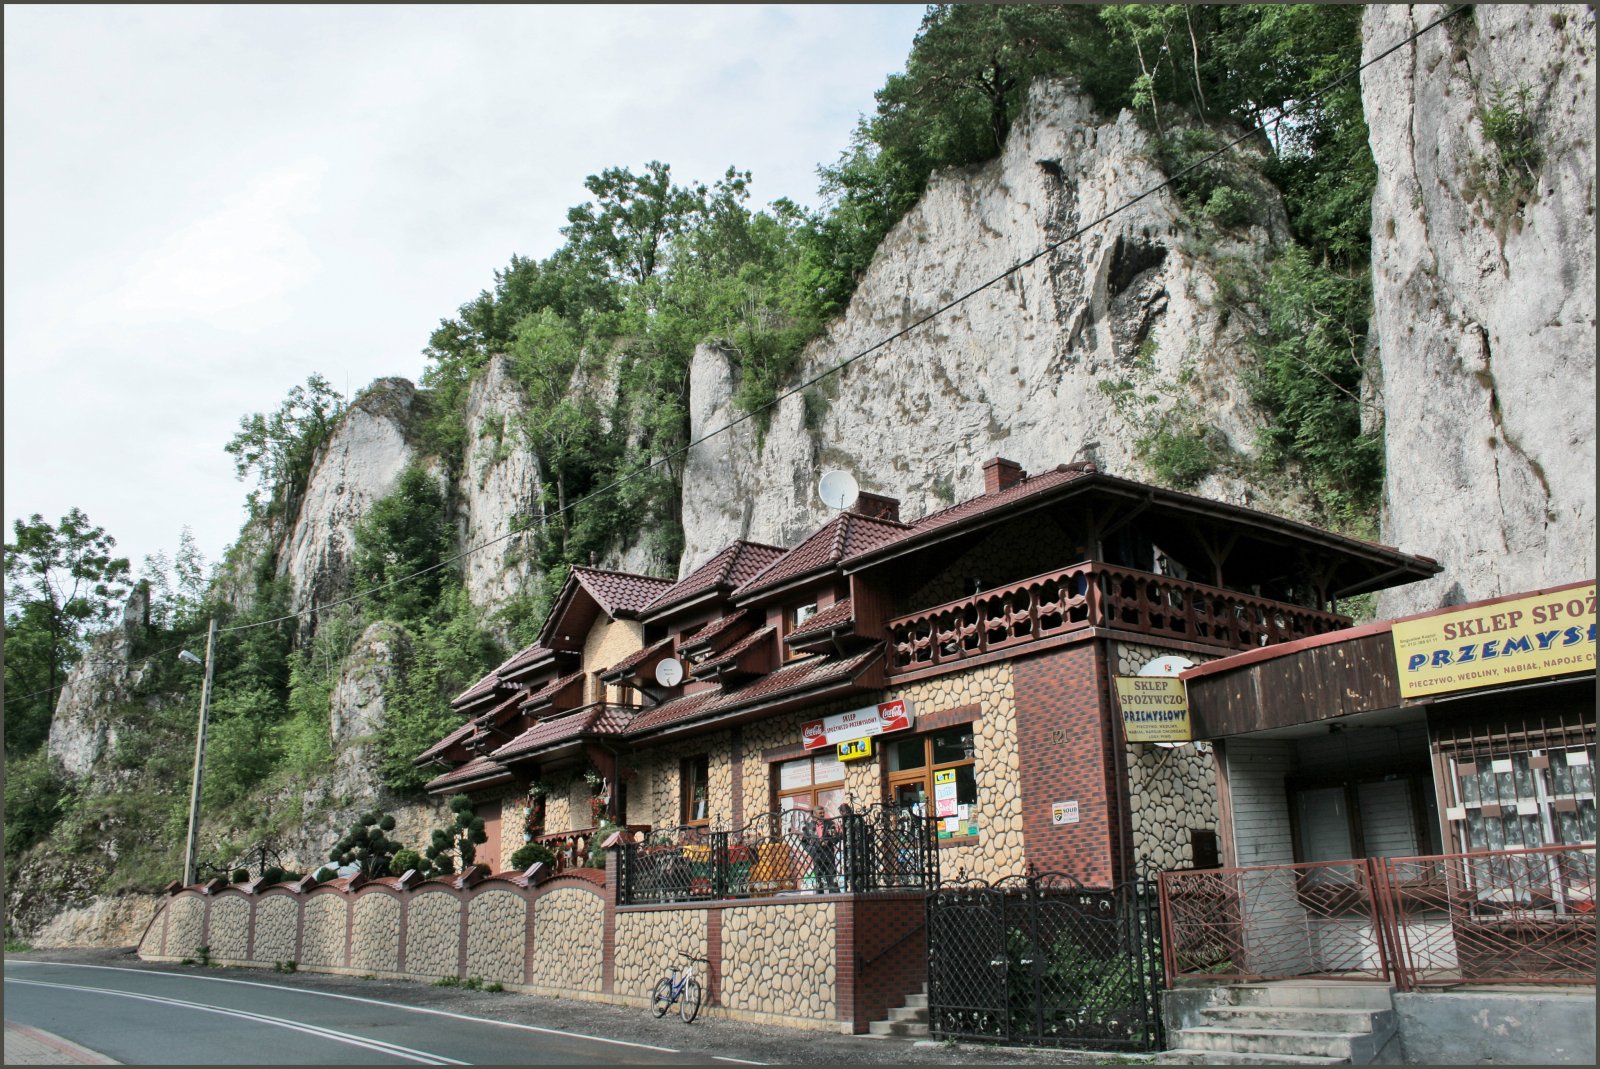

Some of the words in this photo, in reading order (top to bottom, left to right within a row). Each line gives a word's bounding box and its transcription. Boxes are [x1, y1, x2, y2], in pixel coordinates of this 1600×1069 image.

[1443, 610, 1523, 641] SKLEP
[1409, 675, 1456, 689] PIECZYWO,
[1503, 660, 1541, 674] NABIAŁ,
[1543, 655, 1583, 668] NAPOJE
[1134, 681, 1168, 690] SKLEP
[1121, 691, 1186, 705] SPOŻYWCZO-
[842, 713, 856, 723] SKLEP
[1124, 709, 1186, 721] PRZEMYSŁOWY
